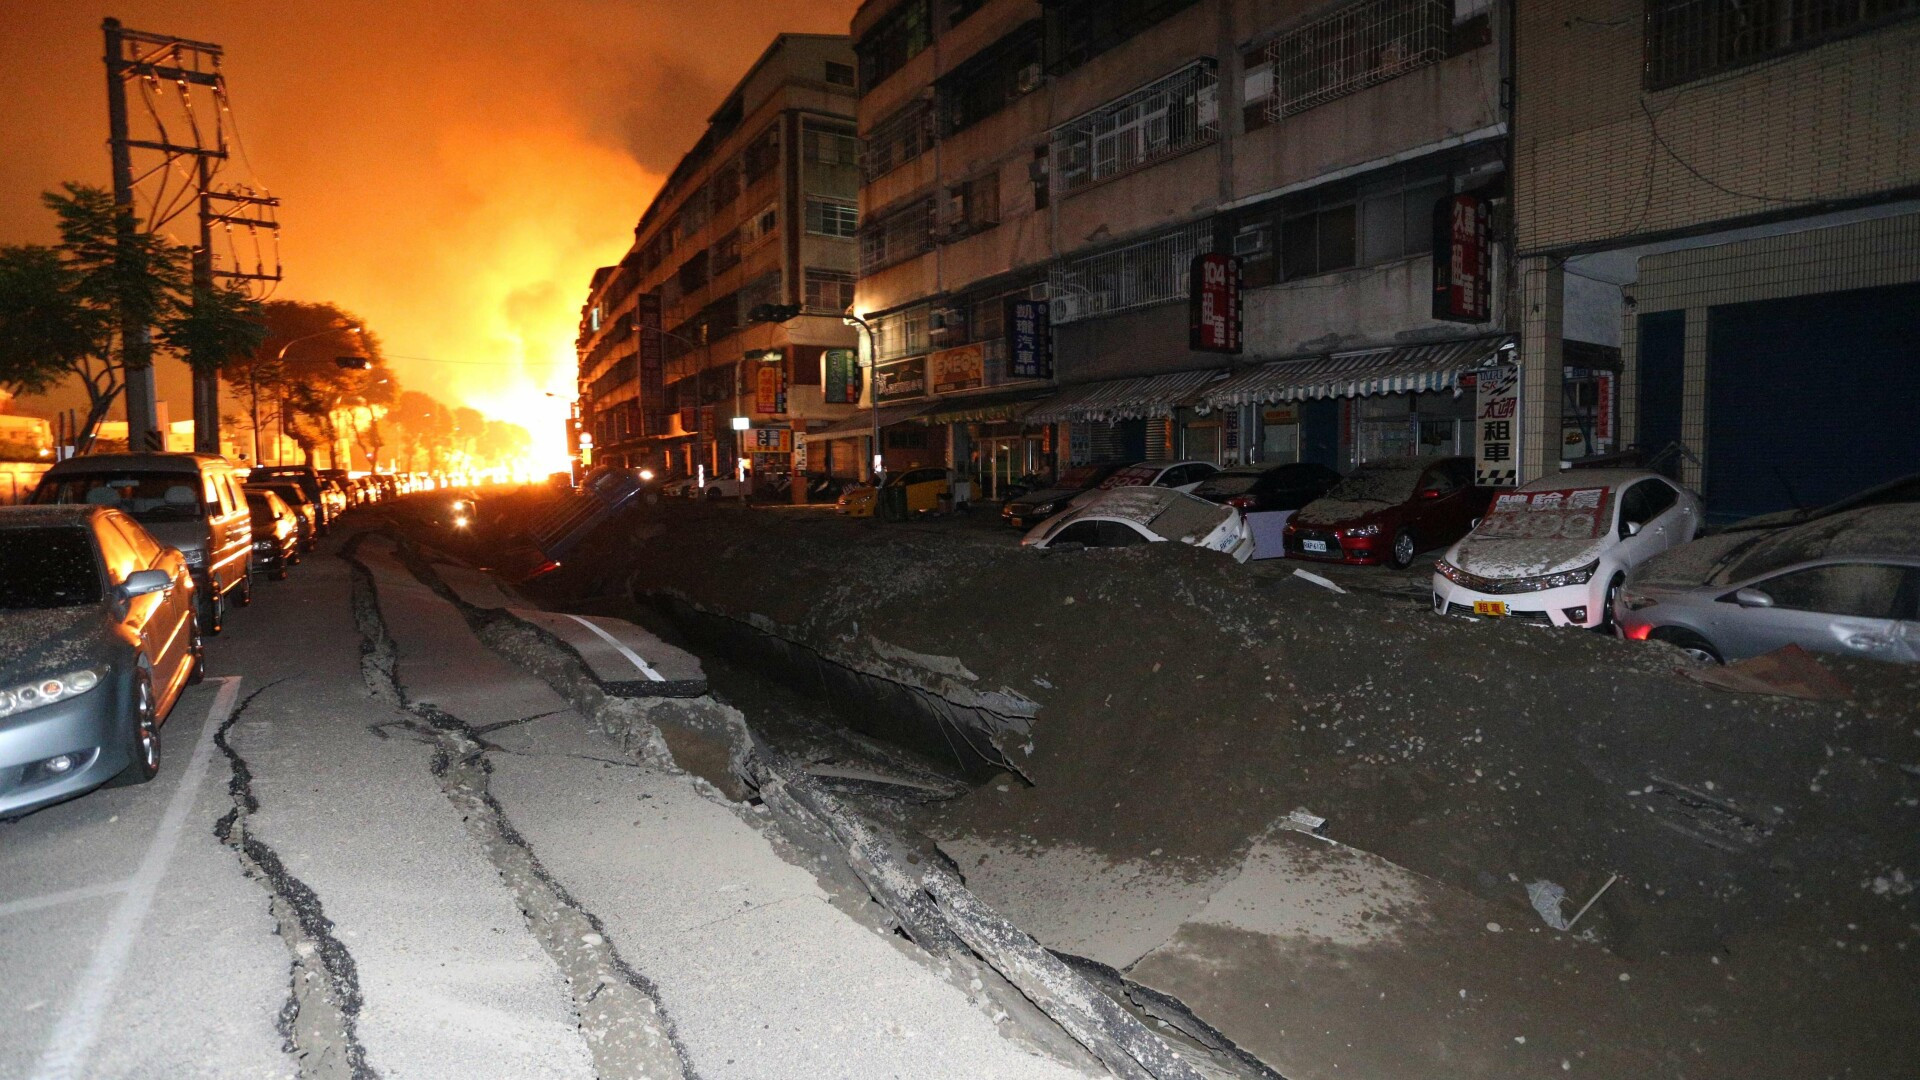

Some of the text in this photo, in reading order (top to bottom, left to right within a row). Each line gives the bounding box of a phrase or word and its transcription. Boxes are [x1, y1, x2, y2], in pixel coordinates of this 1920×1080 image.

[1203, 260, 1226, 286] 104
[1202, 291, 1226, 348] 租車
[936, 353, 981, 376] ENEOS
[1480, 369, 1503, 381] TYPE
[1483, 420, 1510, 462] 租車
[1478, 602, 1502, 613] 租車
